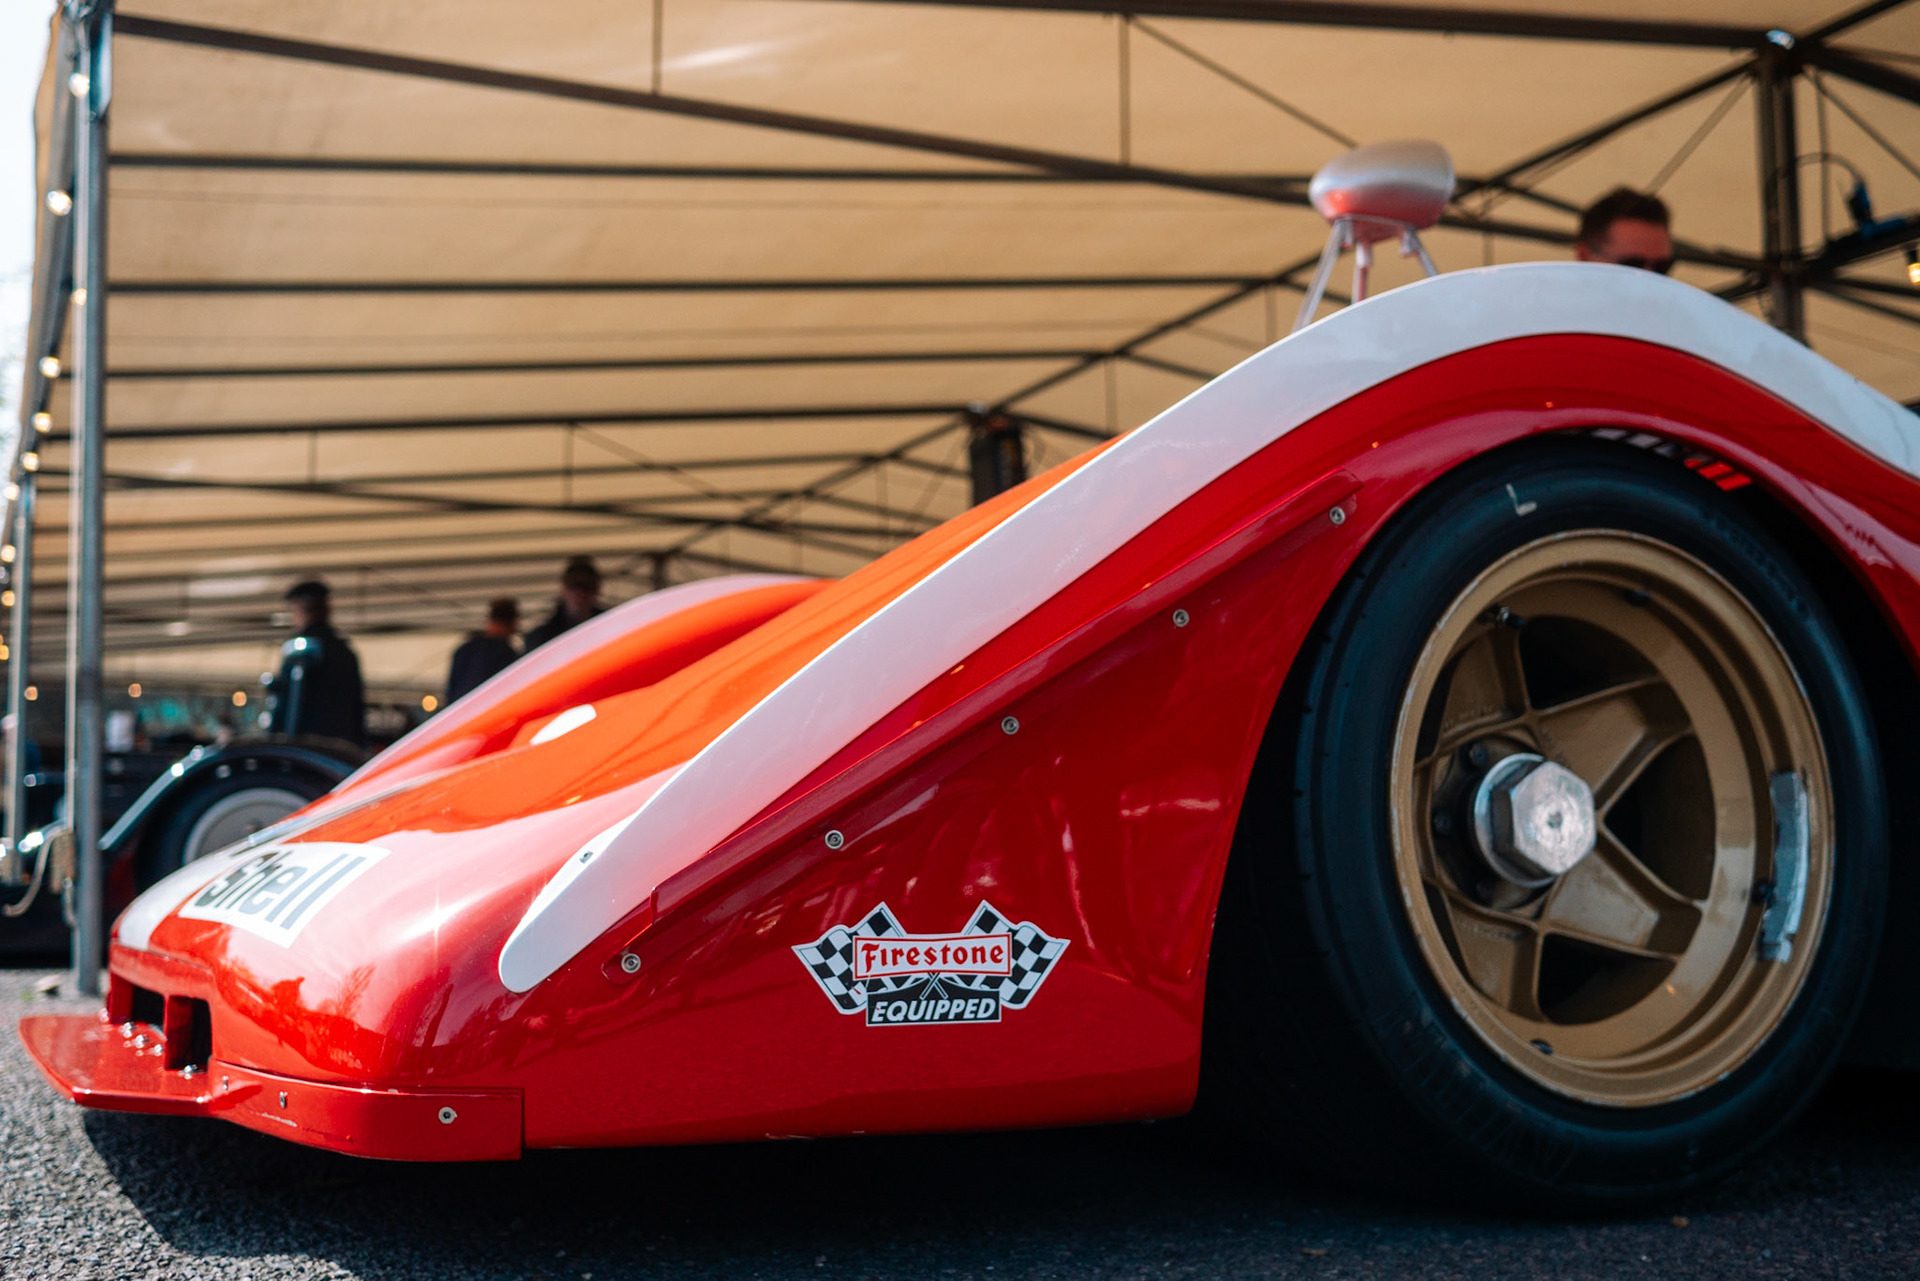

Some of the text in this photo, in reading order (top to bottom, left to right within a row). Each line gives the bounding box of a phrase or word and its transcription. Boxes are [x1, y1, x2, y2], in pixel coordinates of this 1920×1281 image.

[193, 850, 368, 931] Shell
[861, 942, 1005, 974] Firestone
[870, 997, 997, 1023] EQUIPPED
